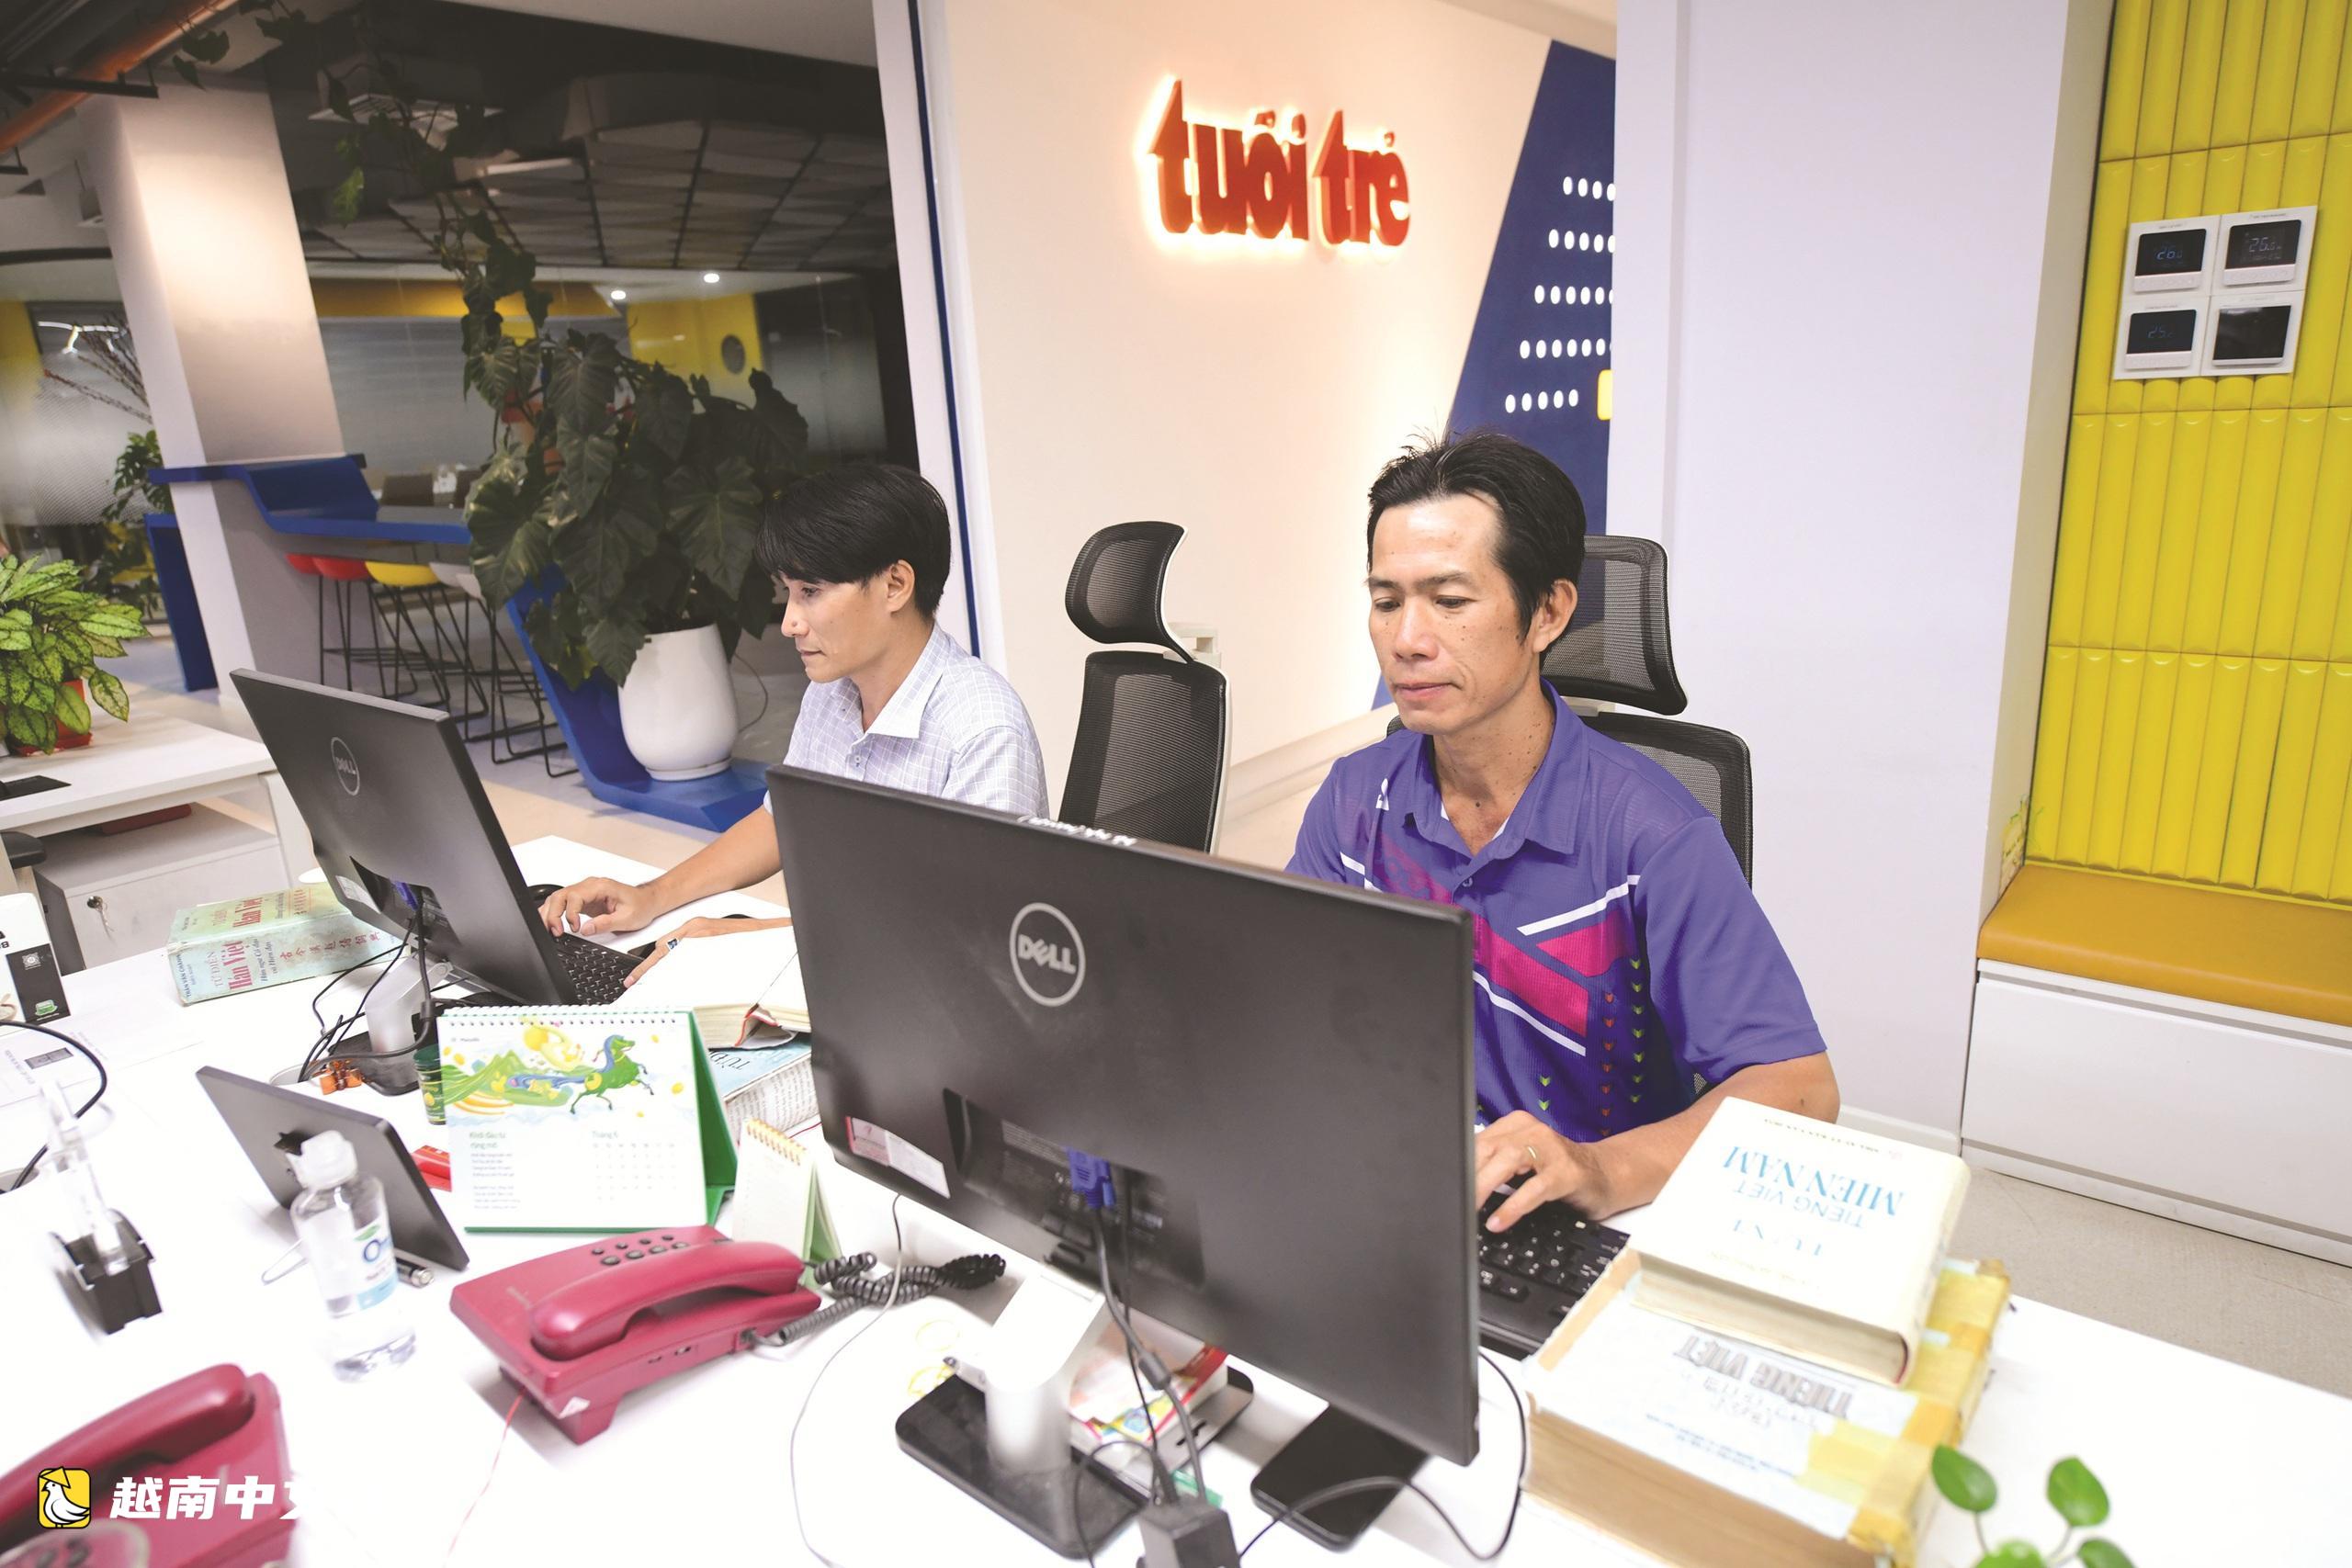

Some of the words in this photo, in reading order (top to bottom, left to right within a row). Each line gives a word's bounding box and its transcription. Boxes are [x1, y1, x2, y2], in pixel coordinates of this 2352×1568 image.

[1312, 109, 1411, 246] trẻ
[221, 941, 250, 965] Việt
[1017, 933, 1077, 976] DELL
[228, 965, 253, 989] Hán
[1723, 1145, 1804, 1188] NAM
